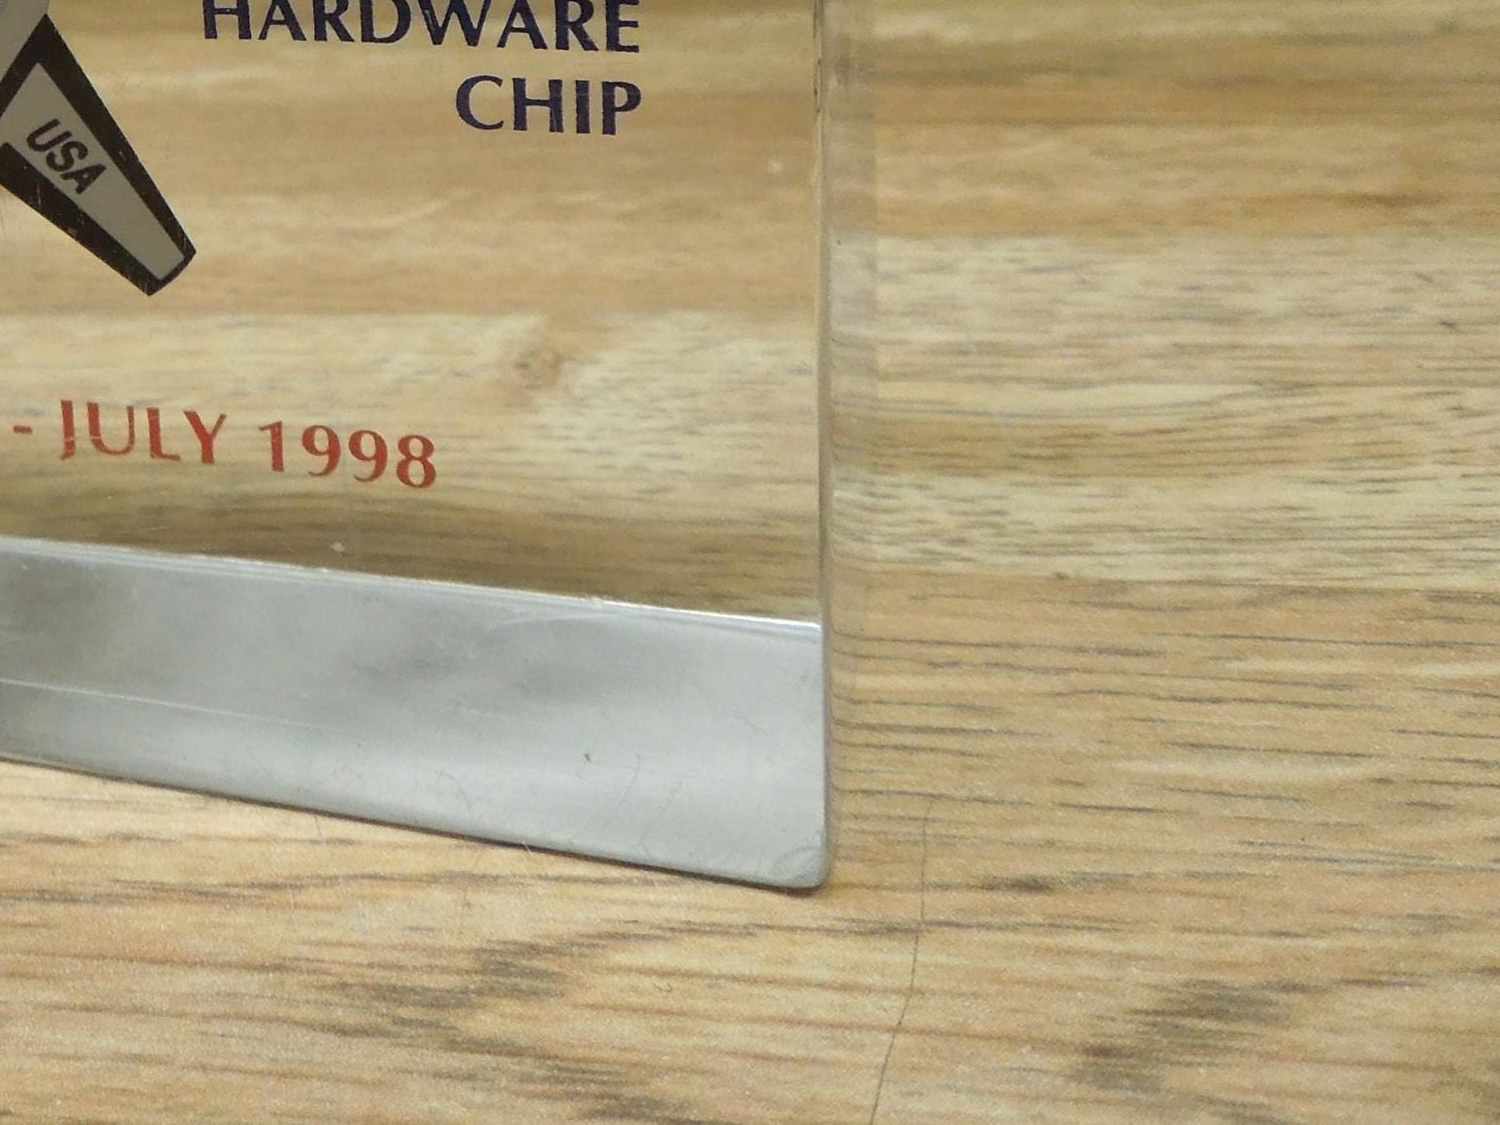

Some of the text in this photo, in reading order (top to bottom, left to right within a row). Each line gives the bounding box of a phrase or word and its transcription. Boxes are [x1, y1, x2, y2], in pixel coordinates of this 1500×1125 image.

[455, 74, 642, 136] CHIP
[26, 118, 106, 194] USA
[59, 399, 228, 465] JULY
[259, 420, 438, 489] 1998
